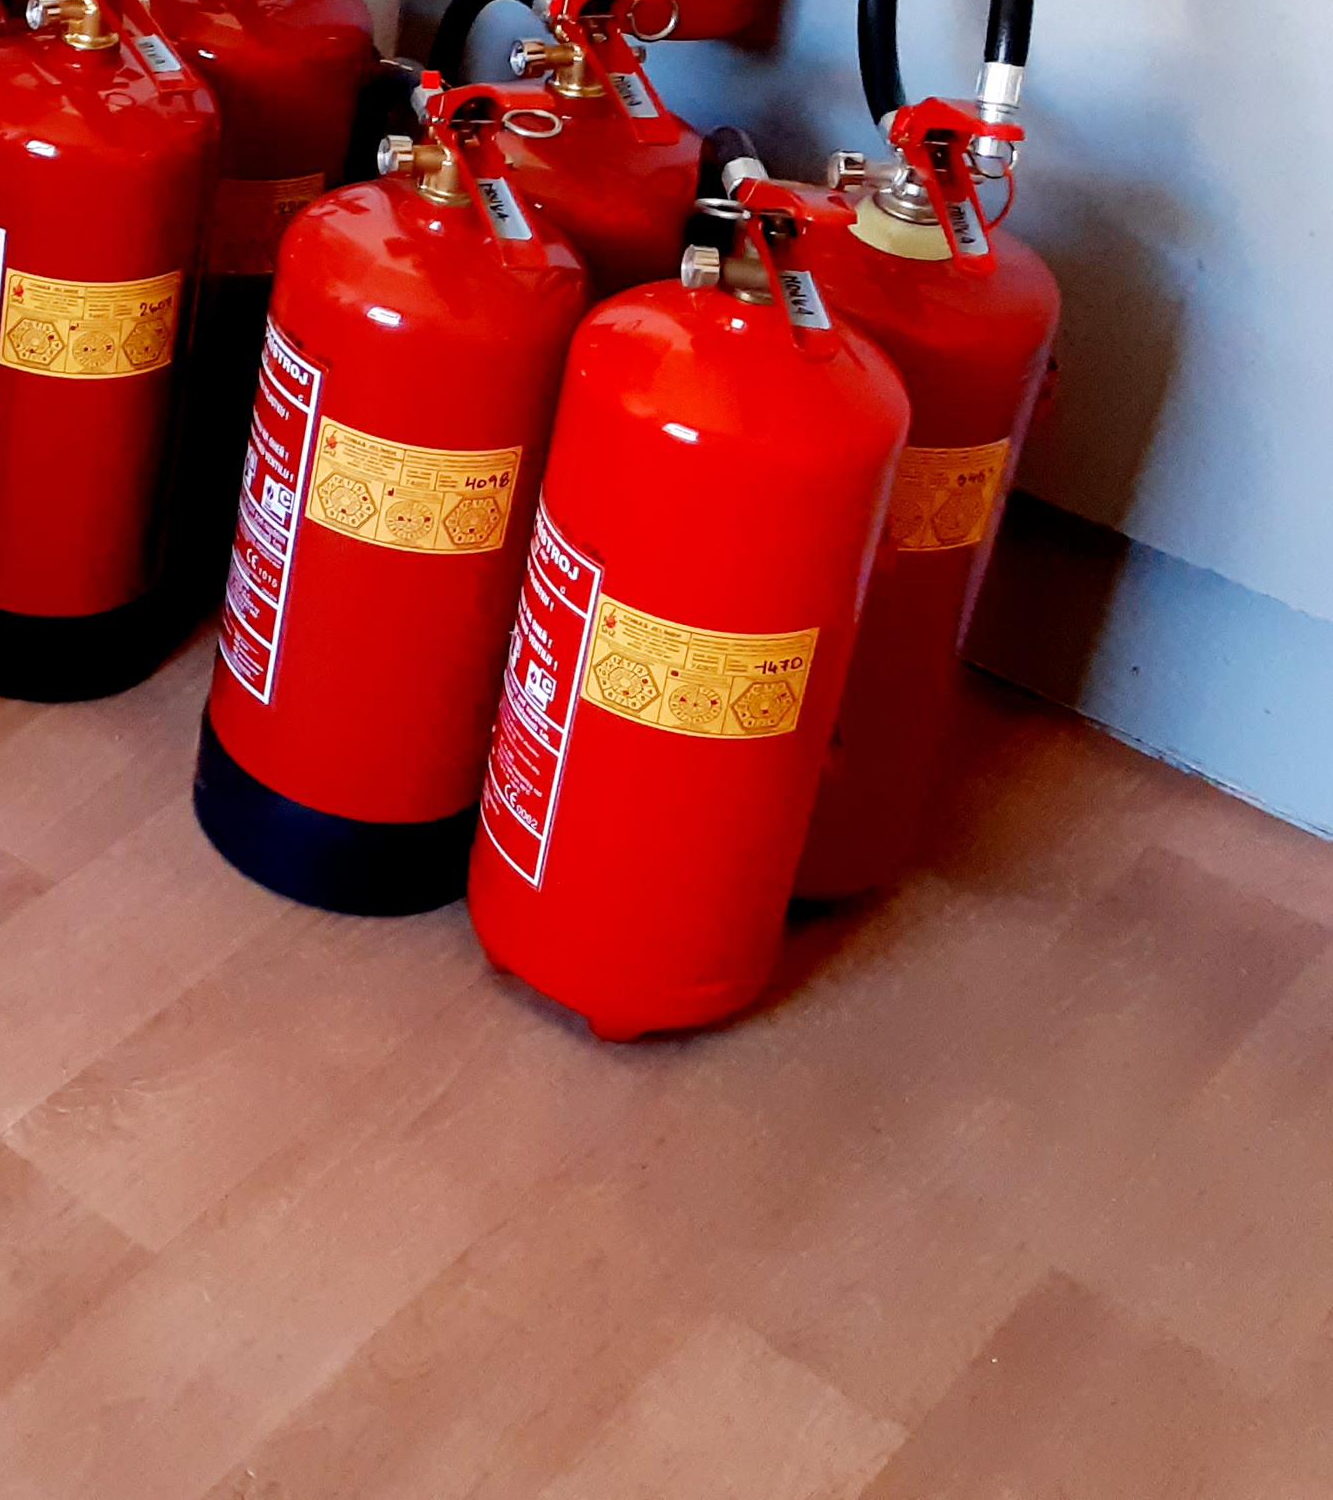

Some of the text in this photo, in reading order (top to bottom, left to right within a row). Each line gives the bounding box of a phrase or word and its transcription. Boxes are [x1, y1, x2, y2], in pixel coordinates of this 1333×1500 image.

[465, 472, 510, 490] 4098
[280, 489, 290, 508] C
[542, 678, 553, 692] C
